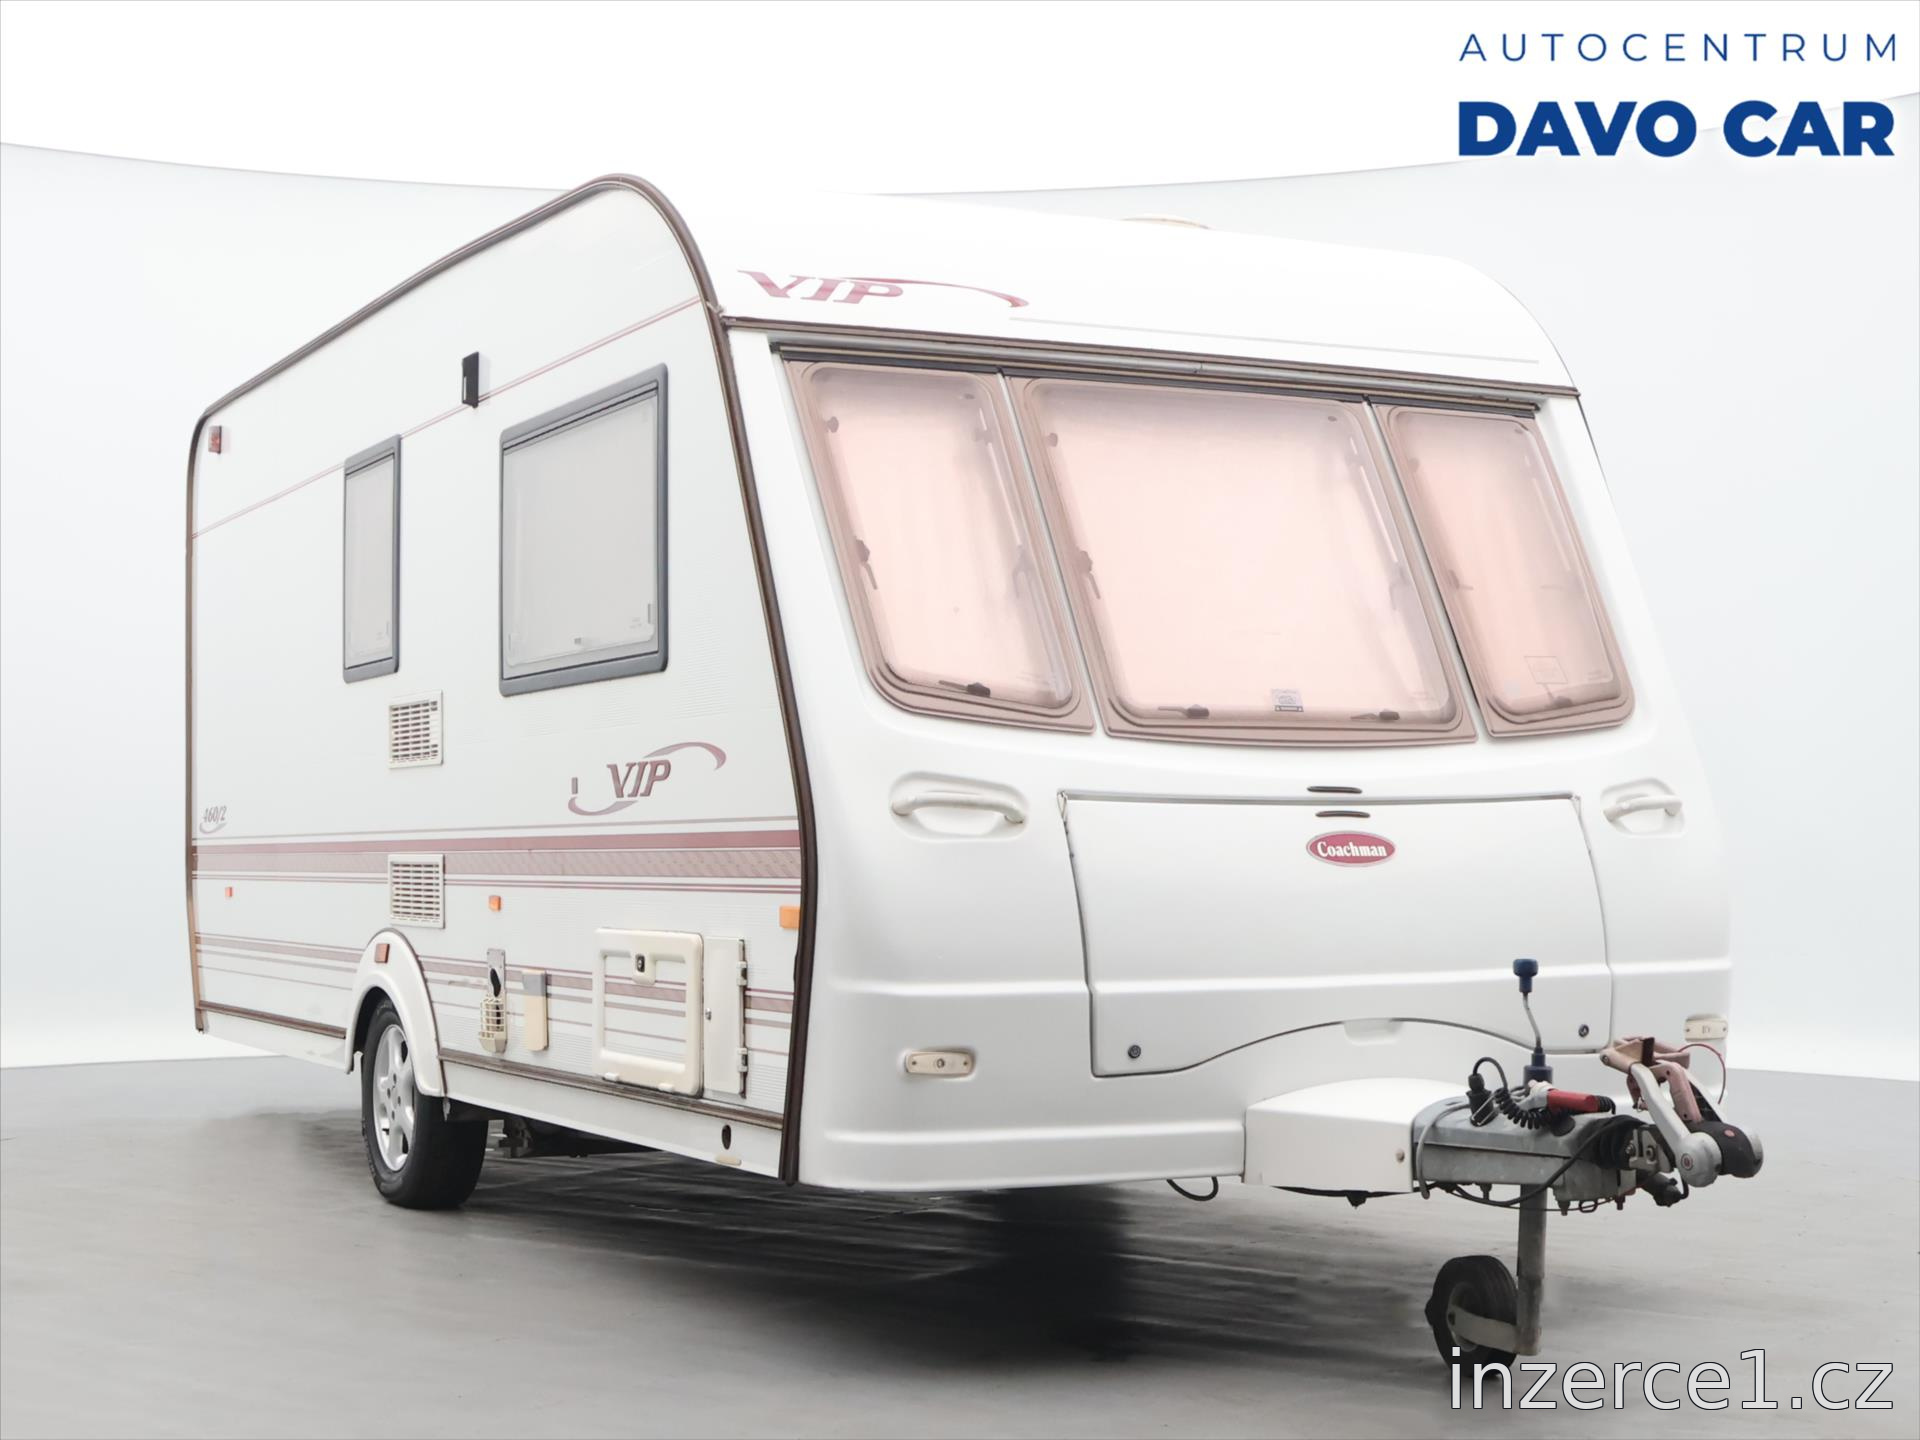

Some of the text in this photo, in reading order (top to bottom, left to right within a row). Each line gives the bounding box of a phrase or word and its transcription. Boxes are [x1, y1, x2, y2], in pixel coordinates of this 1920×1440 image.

[737, 269, 905, 305] VIP
[606, 759, 672, 798] VIP
[1316, 841, 1388, 858] Coachman
